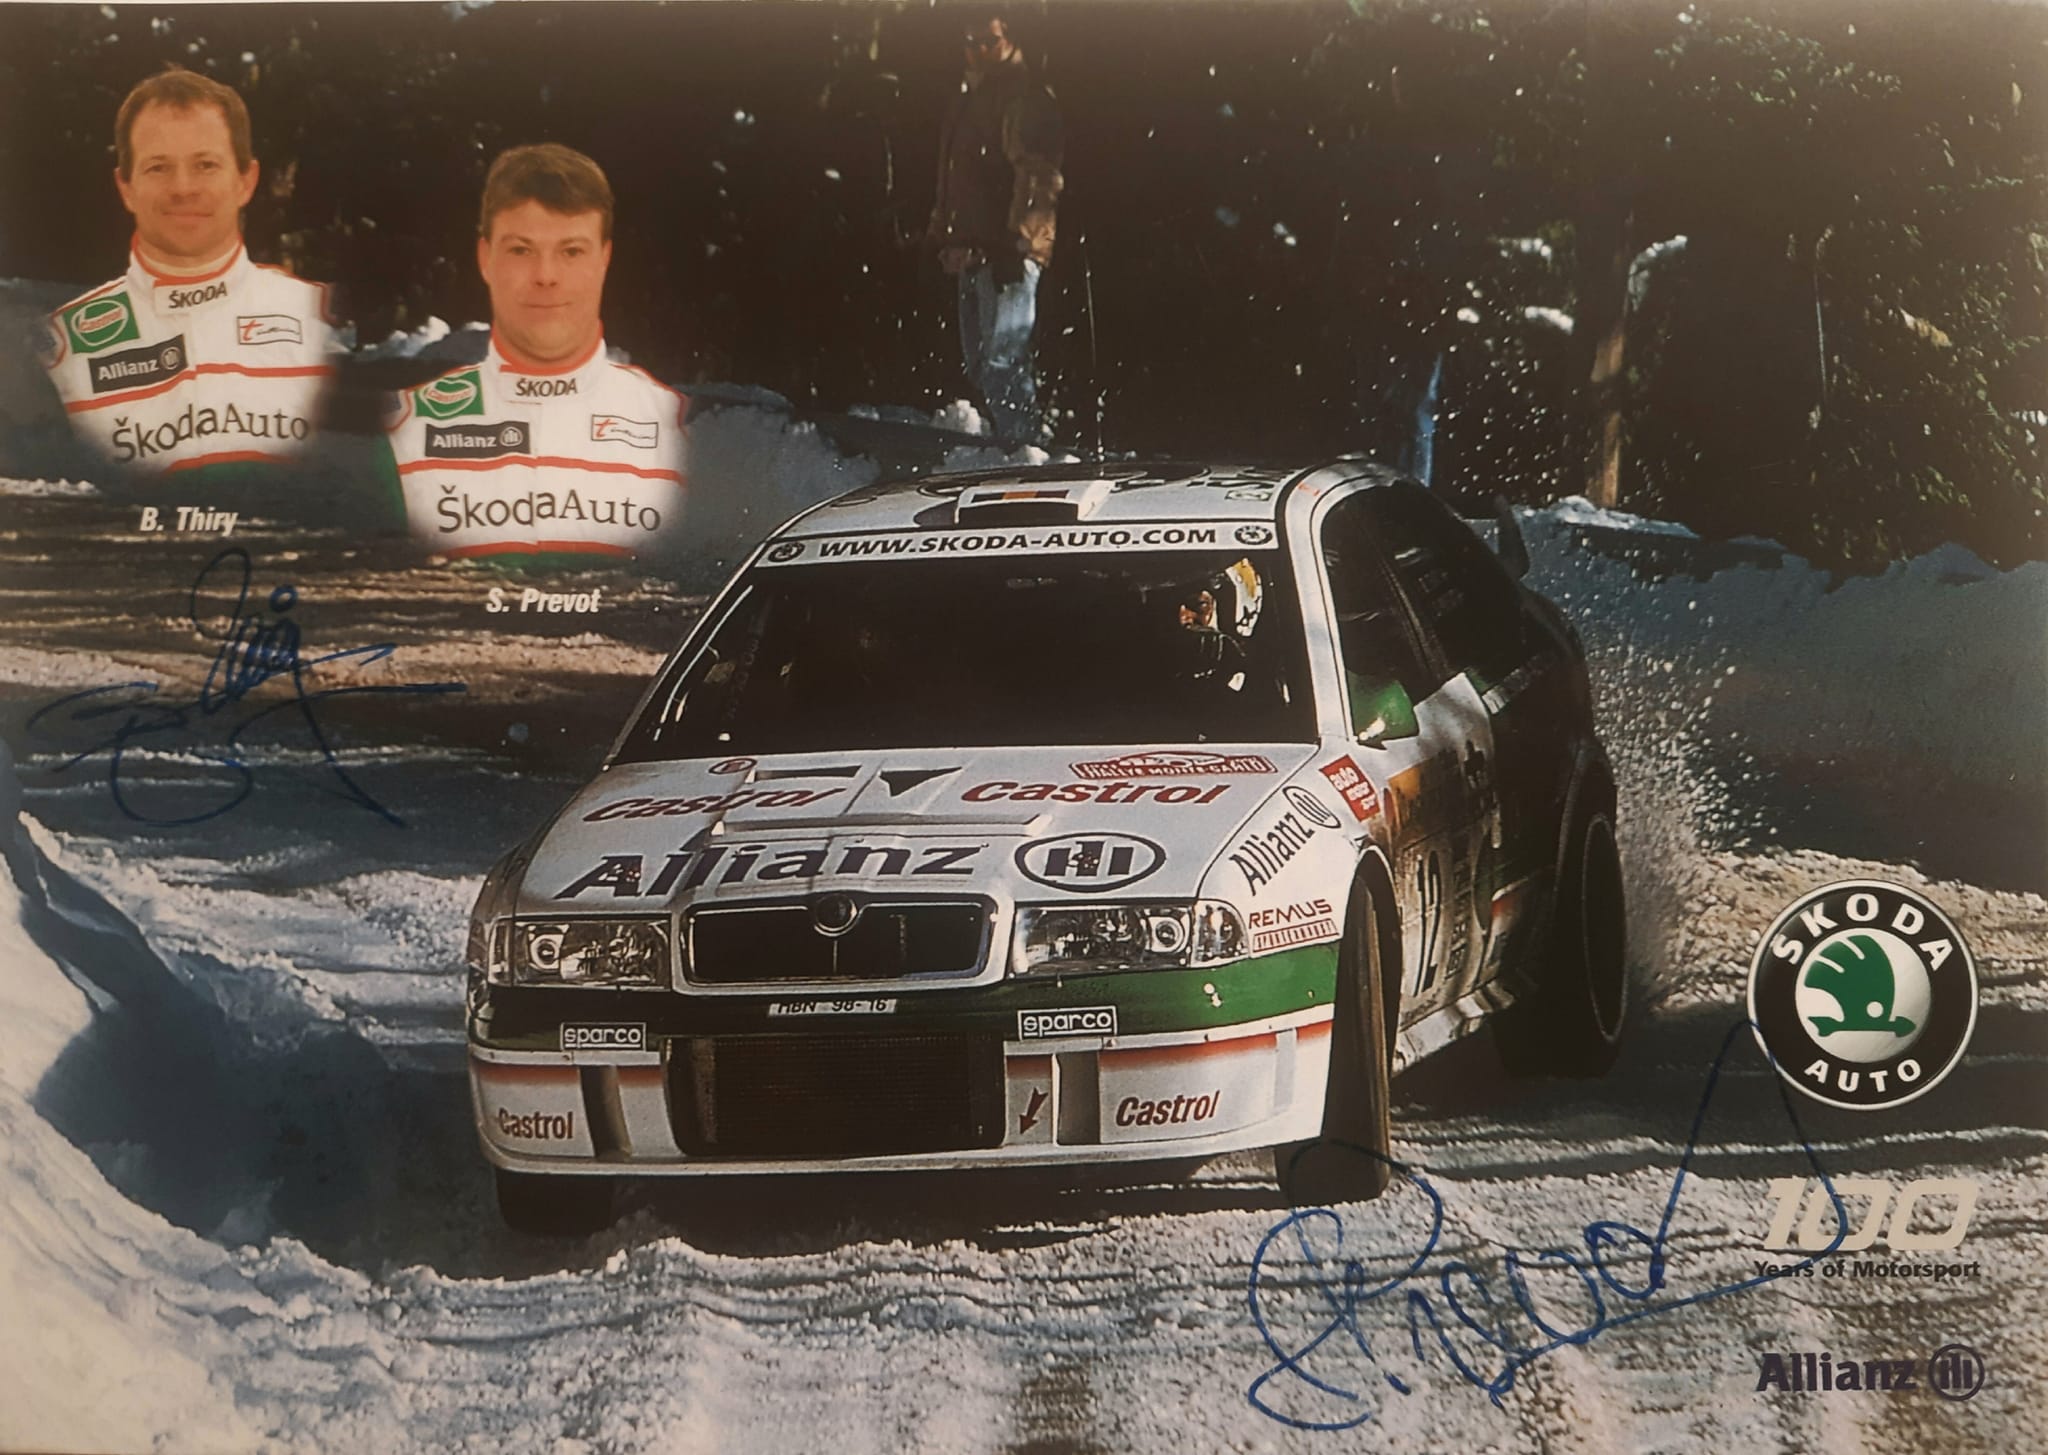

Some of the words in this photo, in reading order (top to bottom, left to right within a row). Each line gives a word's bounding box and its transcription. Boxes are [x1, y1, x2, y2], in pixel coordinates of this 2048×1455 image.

[168, 282, 228, 309] ŠKODA
[99, 359, 158, 380] Allianz
[516, 378, 578, 397] ŠKODA
[113, 402, 311, 462] ŠkodaAuto
[433, 434, 497, 448] Allianz
[140, 504, 164, 531] B.
[176, 503, 238, 537] Thiry
[437, 485, 661, 533] ŠkodaAuto
[820, 528, 1216, 558] WWW.SKODA-AUTO.COM
[487, 587, 510, 613] S.
[521, 587, 602, 613] Prevot
[583, 786, 847, 822] Castrol
[960, 780, 1231, 804] Castrol
[554, 830, 984, 899] Allianz
[1229, 811, 1316, 896] Allianz
[1249, 899, 1332, 929] REMUS
[1770, 893, 1954, 972] SKODA
[564, 1027, 641, 1048] sparco
[1023, 1012, 1112, 1037] sparco
[1804, 1058, 1922, 1093] AUTO
[499, 1108, 573, 1140] Castrol
[1116, 1090, 1220, 1127] Castrol
[1764, 1178, 1979, 1250] 100
[1754, 1261, 1814, 1278] Years
[1822, 1259, 1845, 1278] of
[1853, 1260, 1981, 1282] Motorsport
[1756, 1352, 1917, 1393] Allianz
